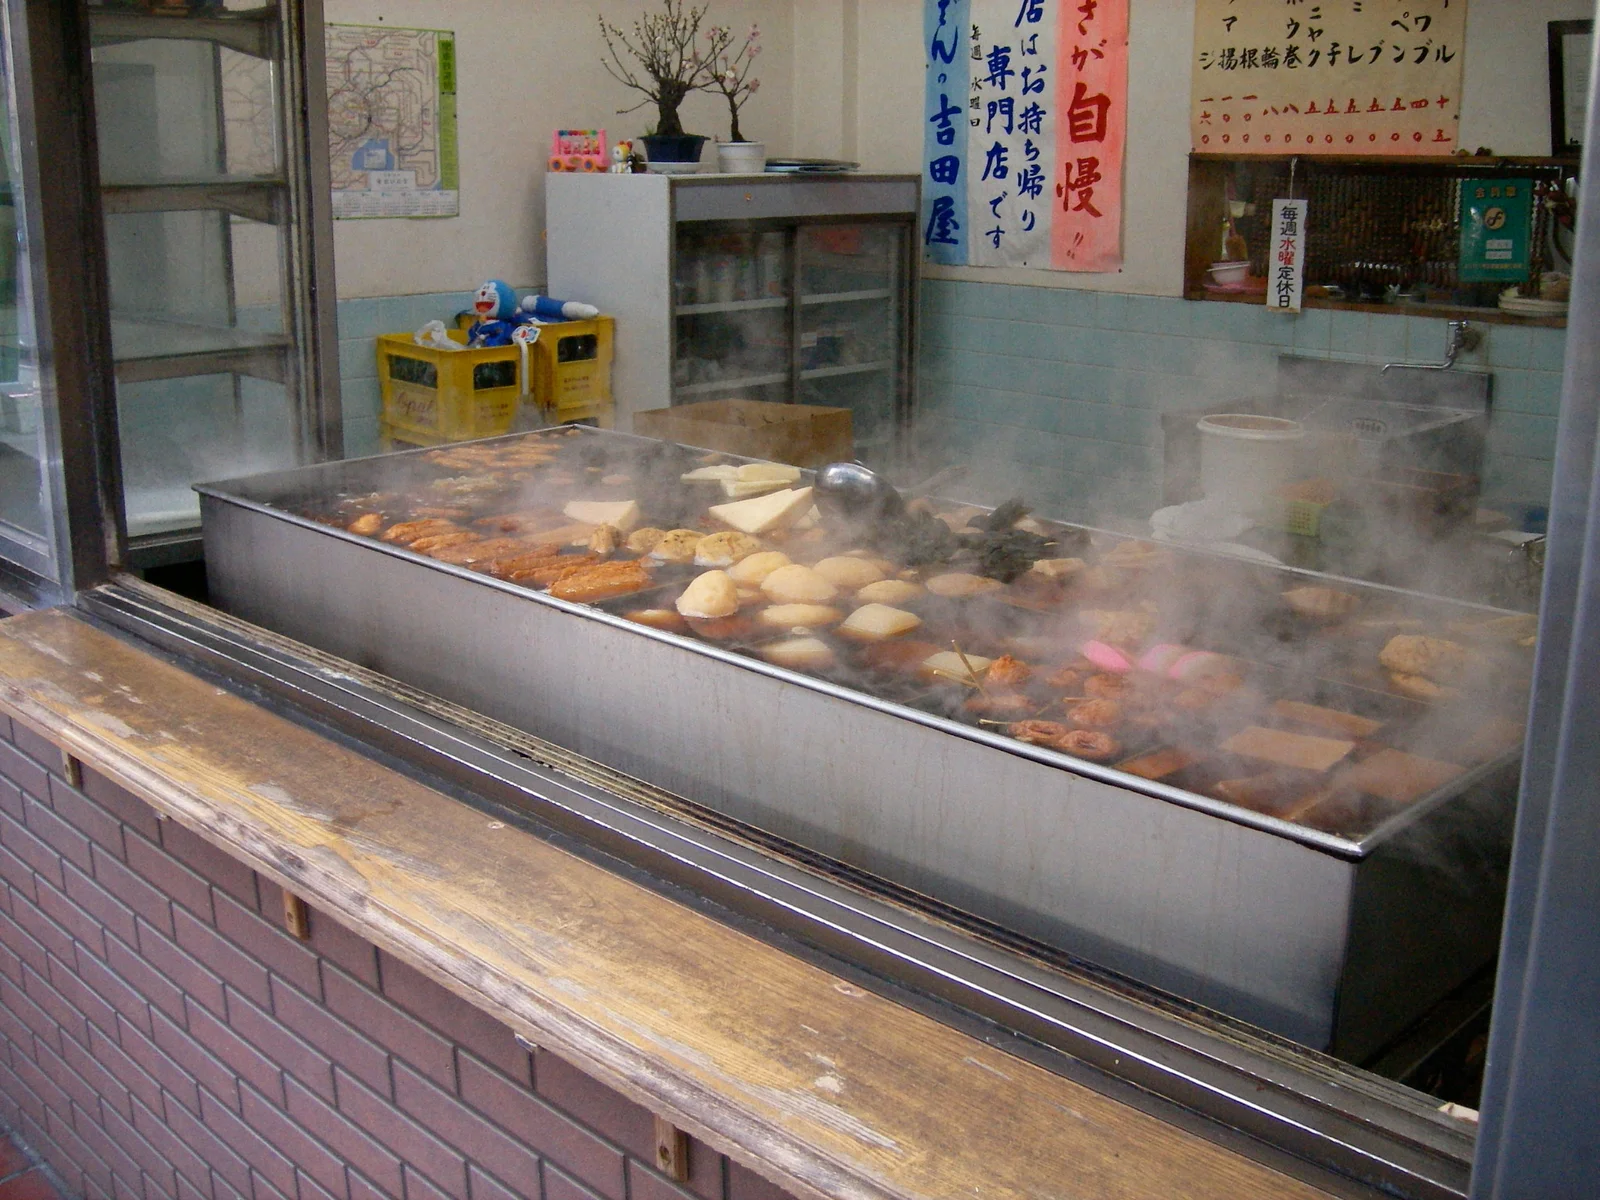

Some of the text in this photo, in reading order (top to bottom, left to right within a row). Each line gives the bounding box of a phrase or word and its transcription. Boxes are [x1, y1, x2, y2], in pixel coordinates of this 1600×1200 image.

[981, 45, 1015, 249] 専門店です
[1276, 205, 1299, 308] 毎週水曜定休日
